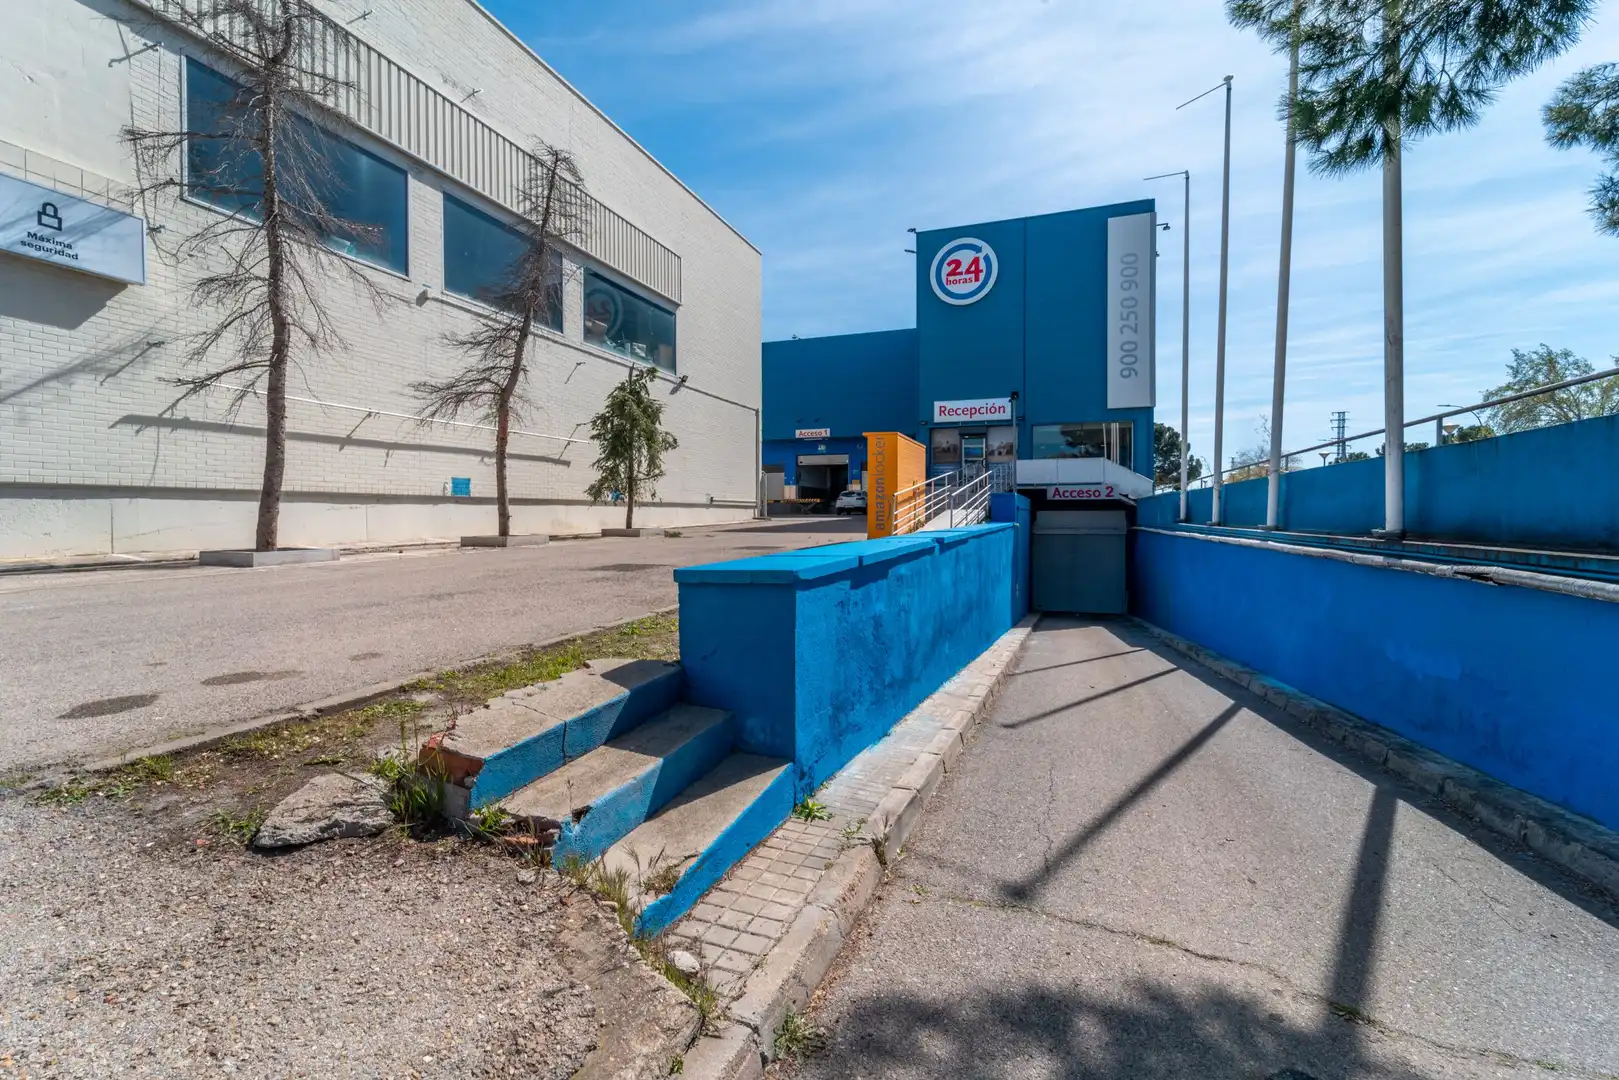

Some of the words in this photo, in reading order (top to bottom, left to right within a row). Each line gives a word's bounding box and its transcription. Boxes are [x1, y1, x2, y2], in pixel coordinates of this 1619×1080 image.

[20, 240, 79, 260] seguridad
[27, 231, 73, 250] Máxima
[946, 256, 983, 282] 24
[1120, 253, 1138, 291] 900
[946, 277, 973, 286] horas
[1120, 296, 1138, 335] 250
[1120, 340, 1138, 379] 900
[939, 402, 1006, 418] Recepción
[1052, 487, 1101, 498] Acceso
[1105, 486, 1114, 498] 2
